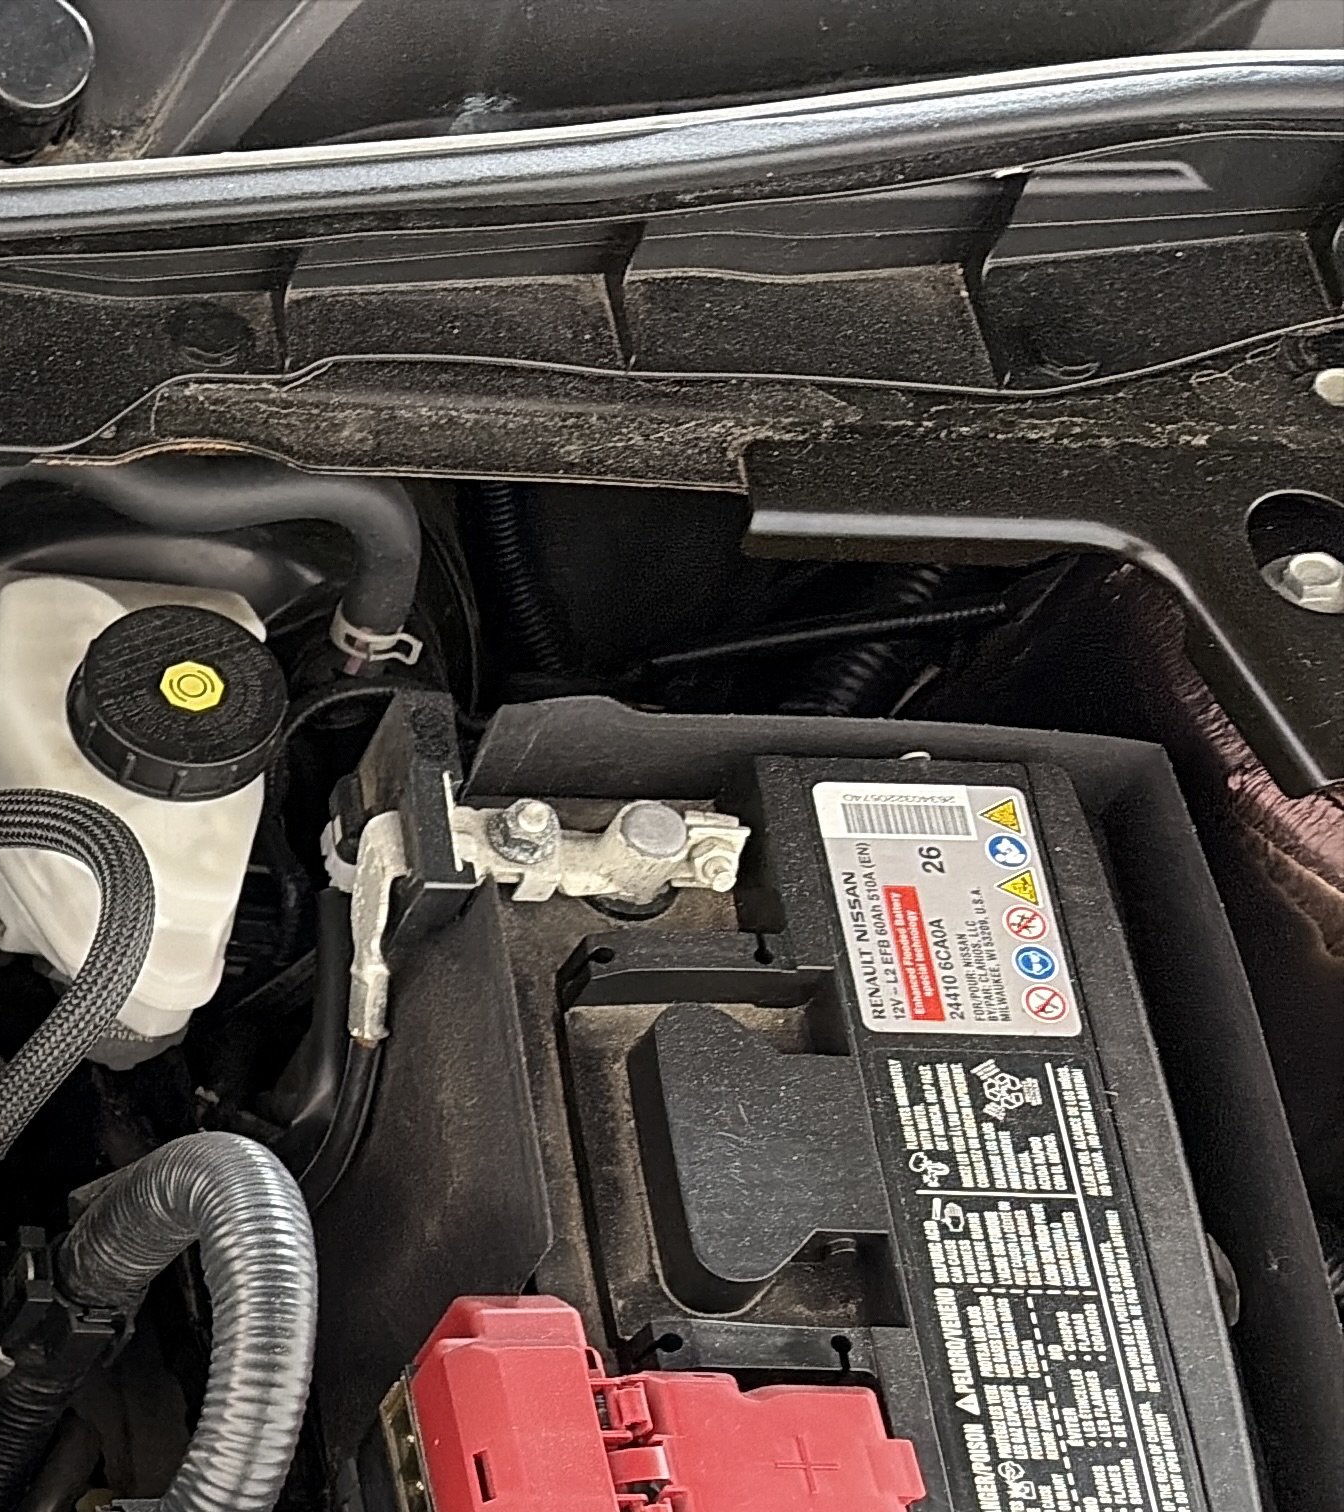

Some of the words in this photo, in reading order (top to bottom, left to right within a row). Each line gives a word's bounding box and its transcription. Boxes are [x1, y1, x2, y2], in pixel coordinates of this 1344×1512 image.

[918, 846, 944, 873] 26
[934, 1288, 973, 1392] PELIGRO/VENENO
[1047, 1344, 1064, 1360] NO
[1061, 1407, 1084, 1446] ÉVITER
[1120, 1458, 1142, 1504] SMOKING
[1082, 1496, 1099, 1512] NO
